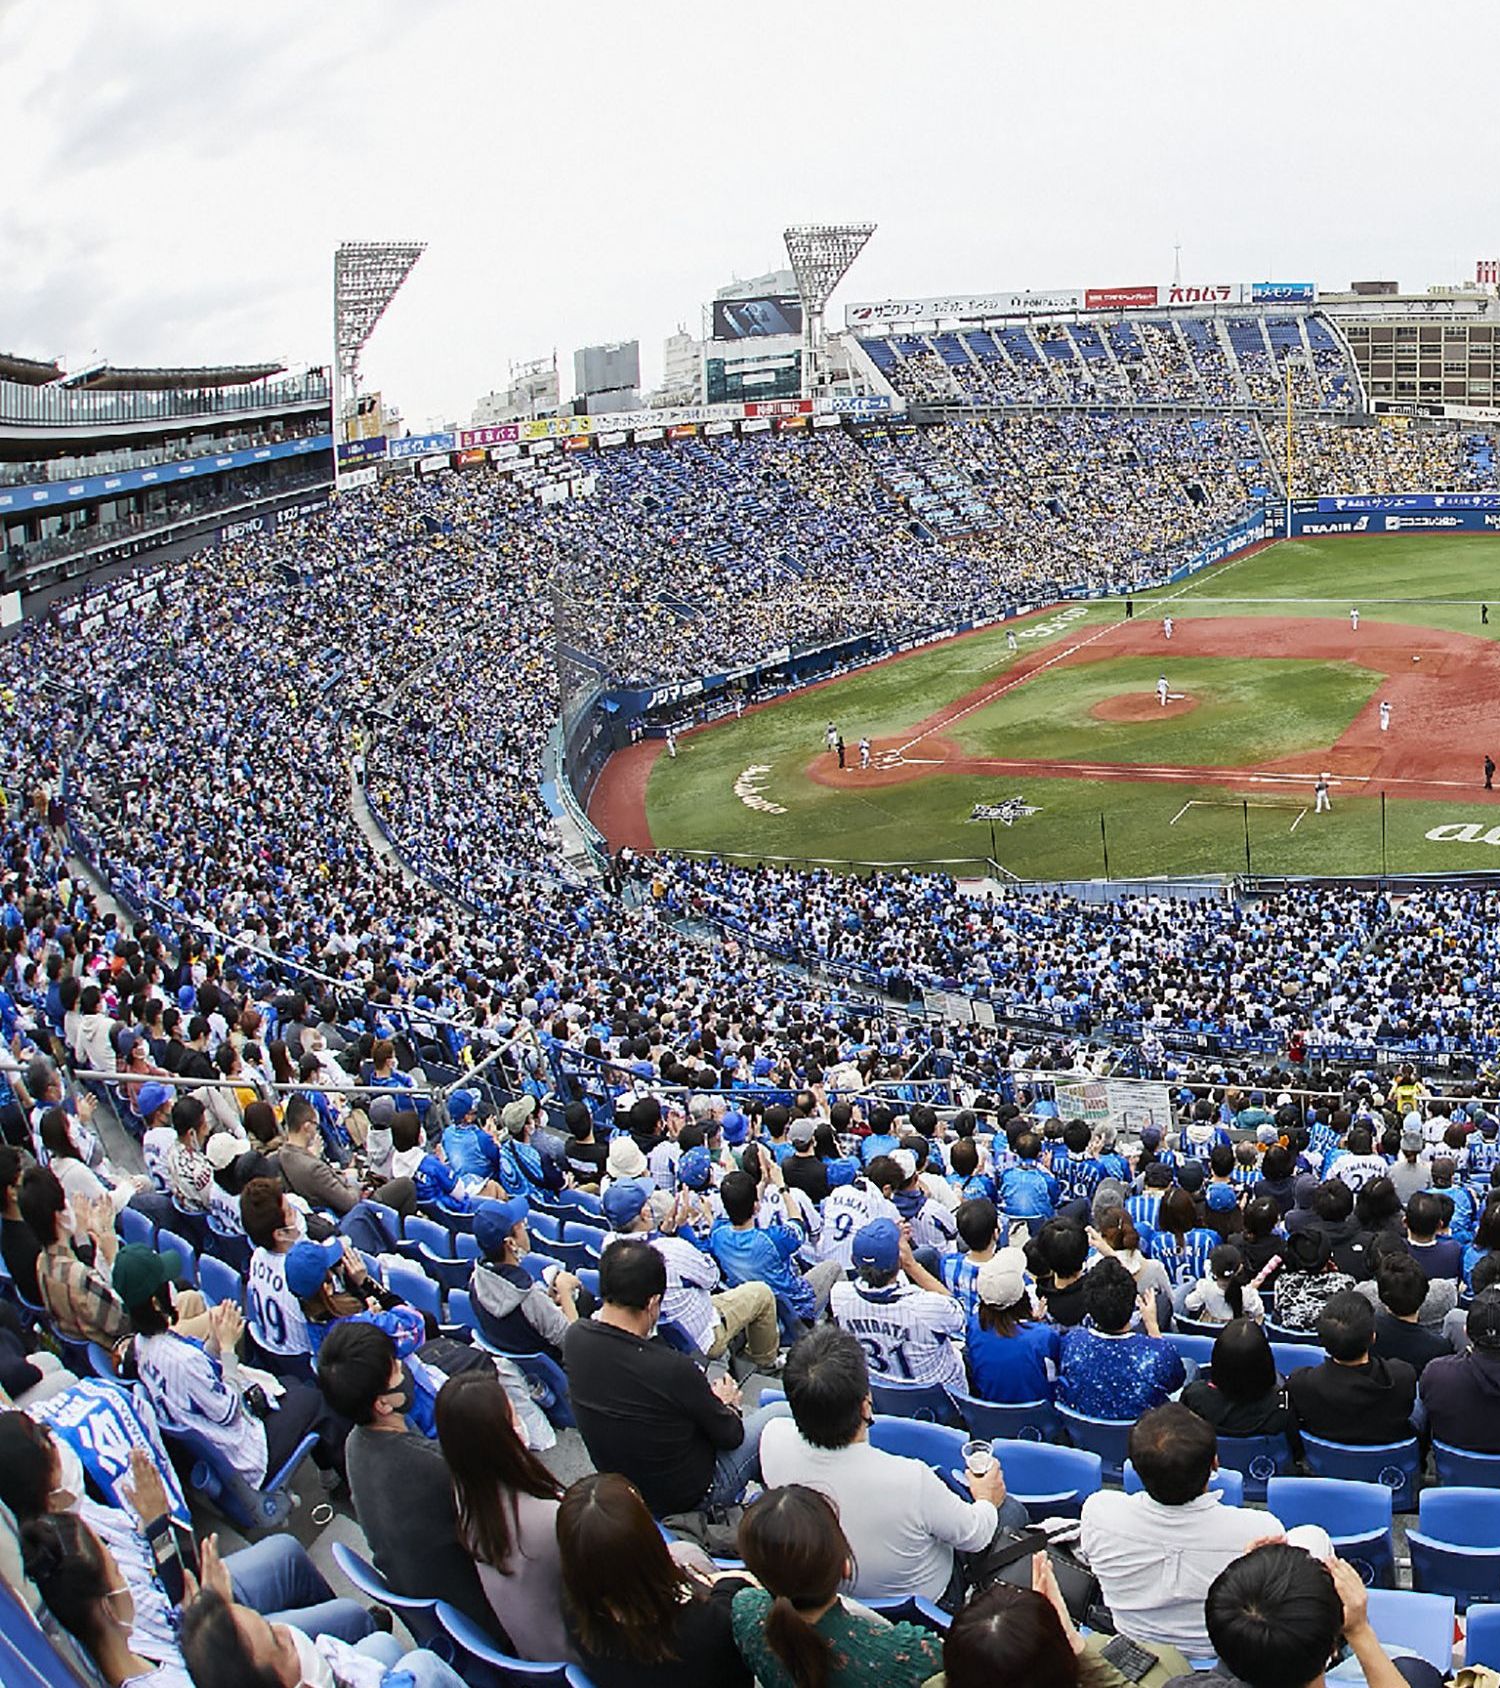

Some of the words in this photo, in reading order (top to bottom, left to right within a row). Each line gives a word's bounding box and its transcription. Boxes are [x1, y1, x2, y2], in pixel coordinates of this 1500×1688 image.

[1169, 285, 1231, 303] オカムラ
[874, 303, 924, 318] サニクリーン
[1399, 516, 1464, 527] ニコニコレンタカー
[647, 684, 681, 709] ノジマ
[833, 1213, 853, 1241] 9
